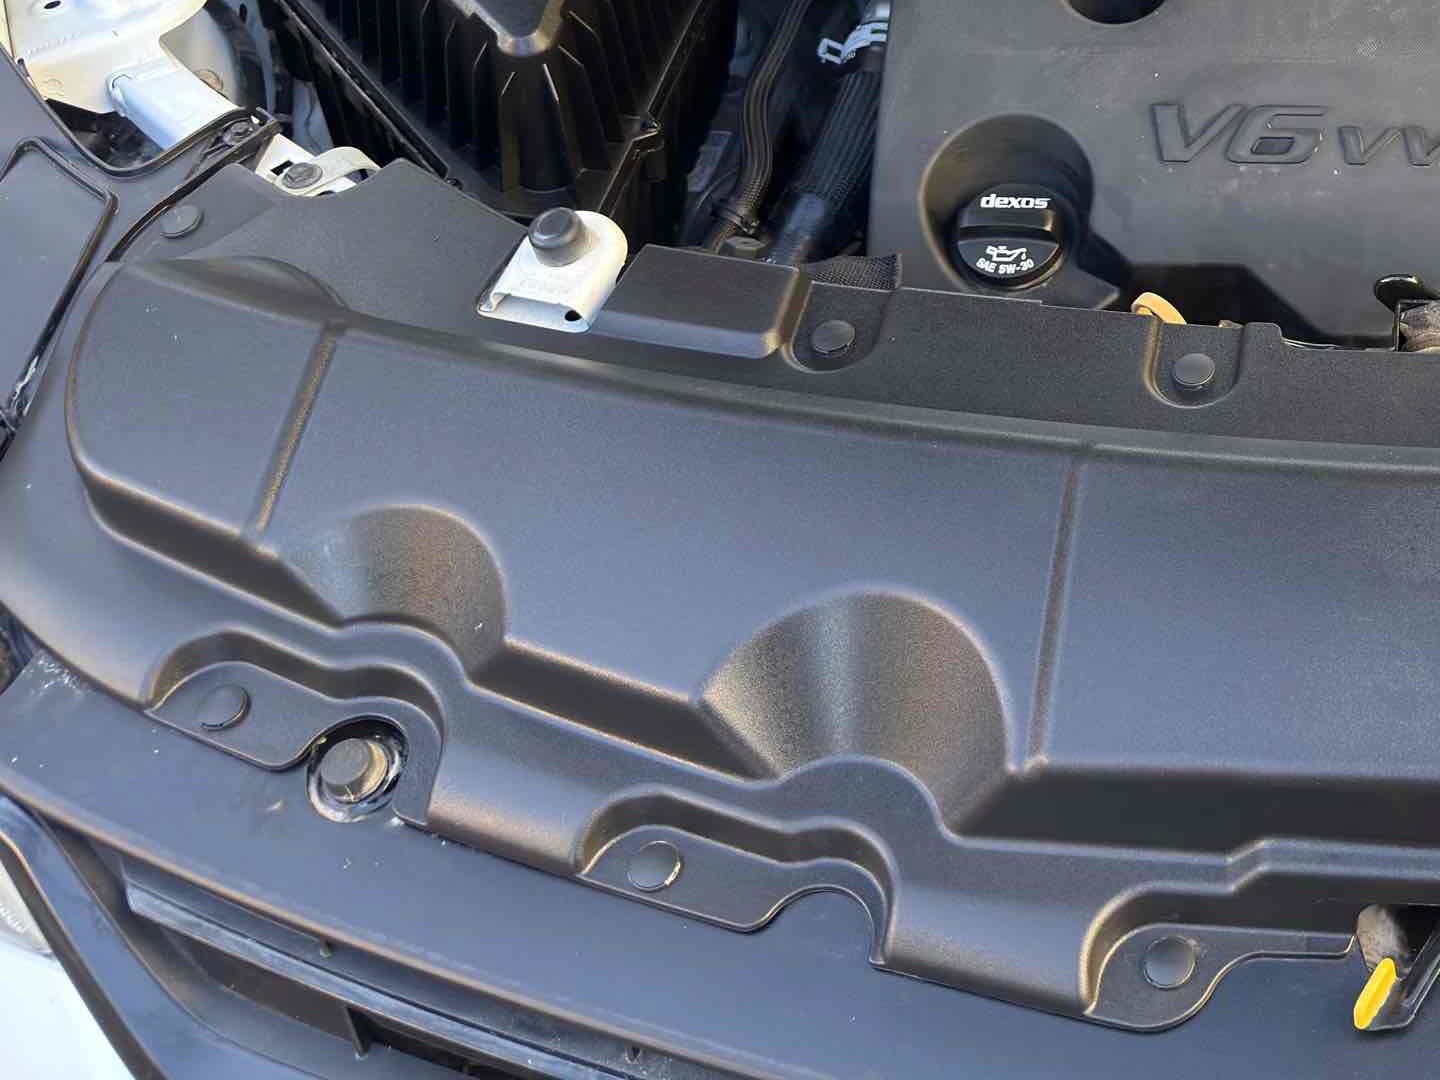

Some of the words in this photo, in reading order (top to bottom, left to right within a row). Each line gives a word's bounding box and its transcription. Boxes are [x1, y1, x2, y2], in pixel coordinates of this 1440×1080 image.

[1149, 101, 1330, 165] V6
[980, 193, 1051, 209] dexos
[976, 259, 996, 273] SAE
[998, 258, 1034, 275] 5W-30
